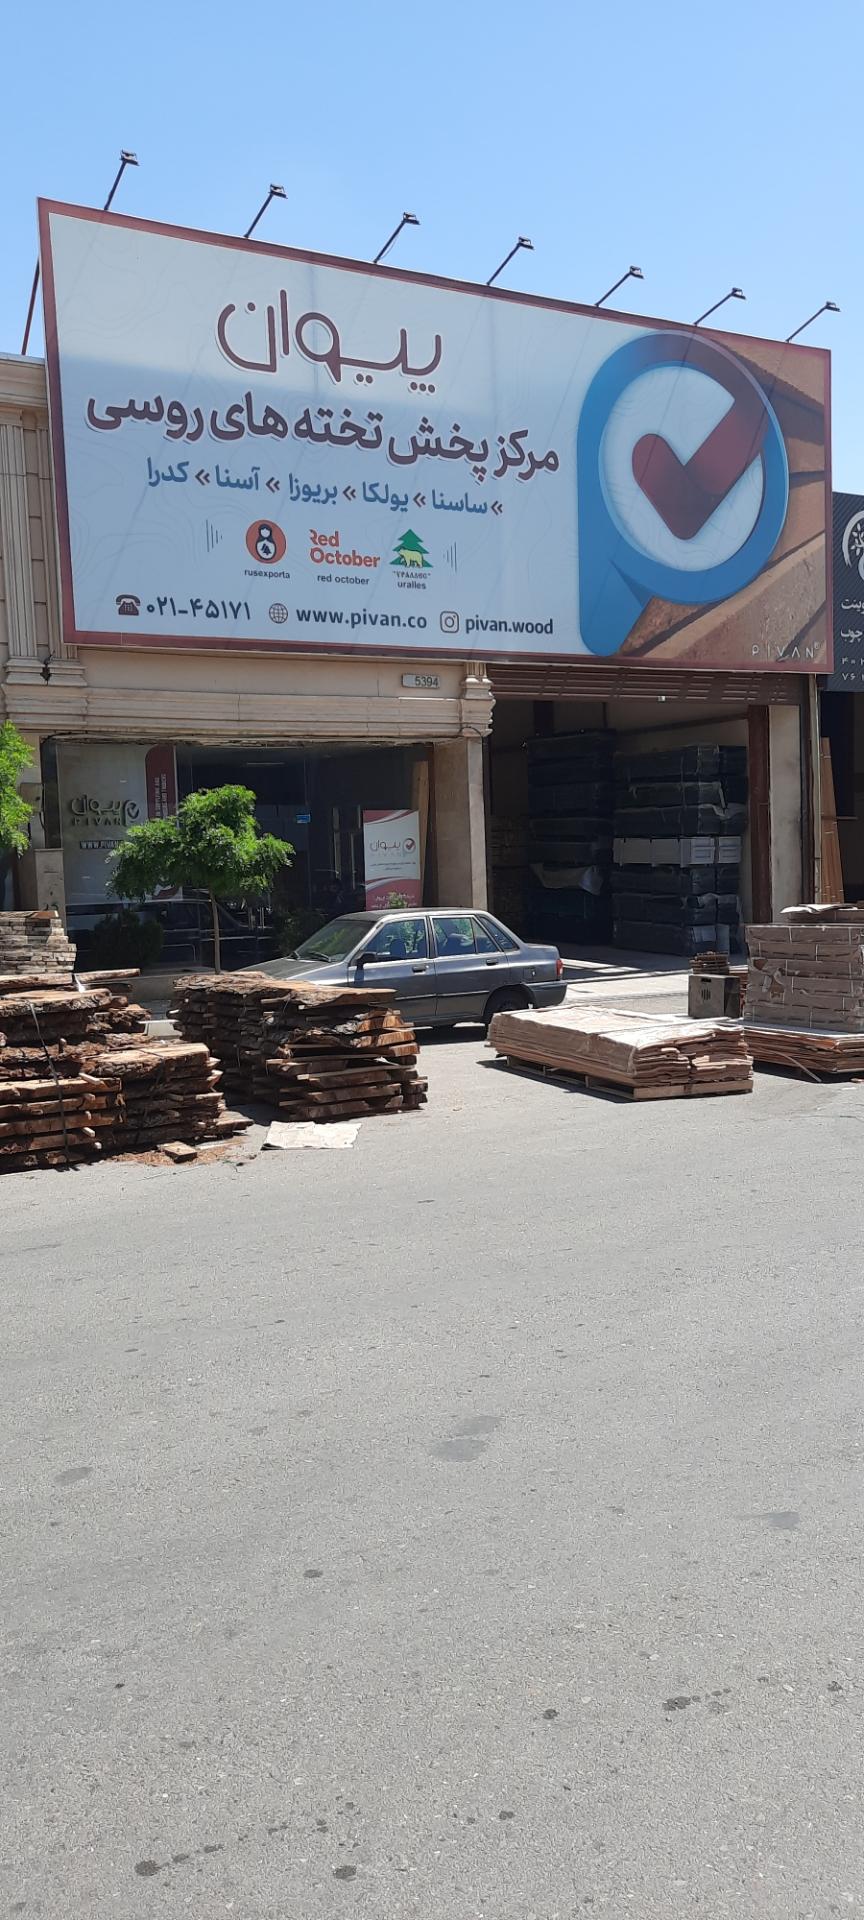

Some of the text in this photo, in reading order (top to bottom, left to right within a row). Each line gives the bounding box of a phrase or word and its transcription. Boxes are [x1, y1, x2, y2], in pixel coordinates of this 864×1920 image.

[217, 289, 442, 393] پیوان
[87, 395, 204, 442] روسی
[388, 416, 489, 482] پخش
[493, 429, 560, 481] مرکز
[147, 457, 488, 514] ساسنا یولکا بریوزا آسنا کدرا
[309, 528, 340, 547] Red
[309, 547, 381, 568] October
[244, 568, 291, 579] rusexporta
[316, 573, 370, 585] red october
[397, 581, 427, 590] uralles
[296, 608, 428, 629] www.pivan.co
[465, 616, 554, 635] pivan.wood
[415, 676, 439, 687] 5394
